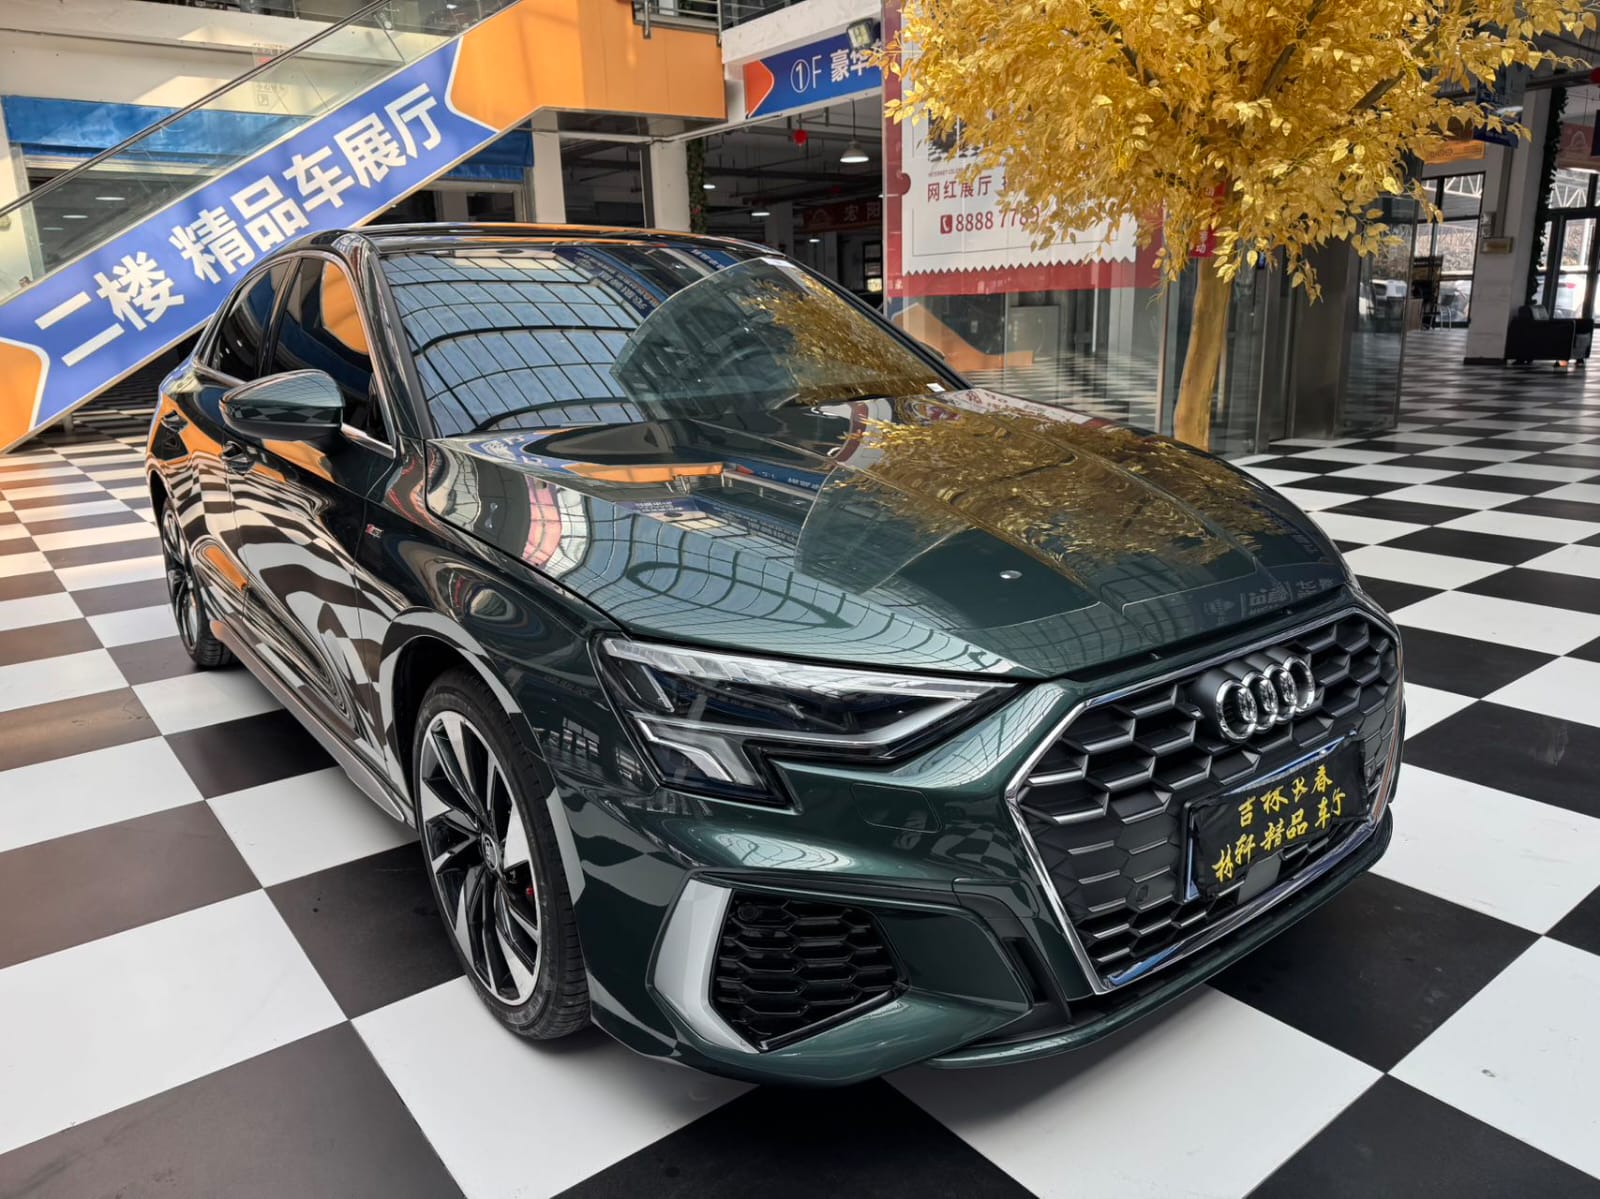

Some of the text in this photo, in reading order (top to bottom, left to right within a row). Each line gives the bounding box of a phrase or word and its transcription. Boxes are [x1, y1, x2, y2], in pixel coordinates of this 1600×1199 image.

[34, 82, 443, 367] 二楼 精品车展厅
[955, 210, 994, 233] 8888
[1238, 764, 1333, 828] 吉林长春
